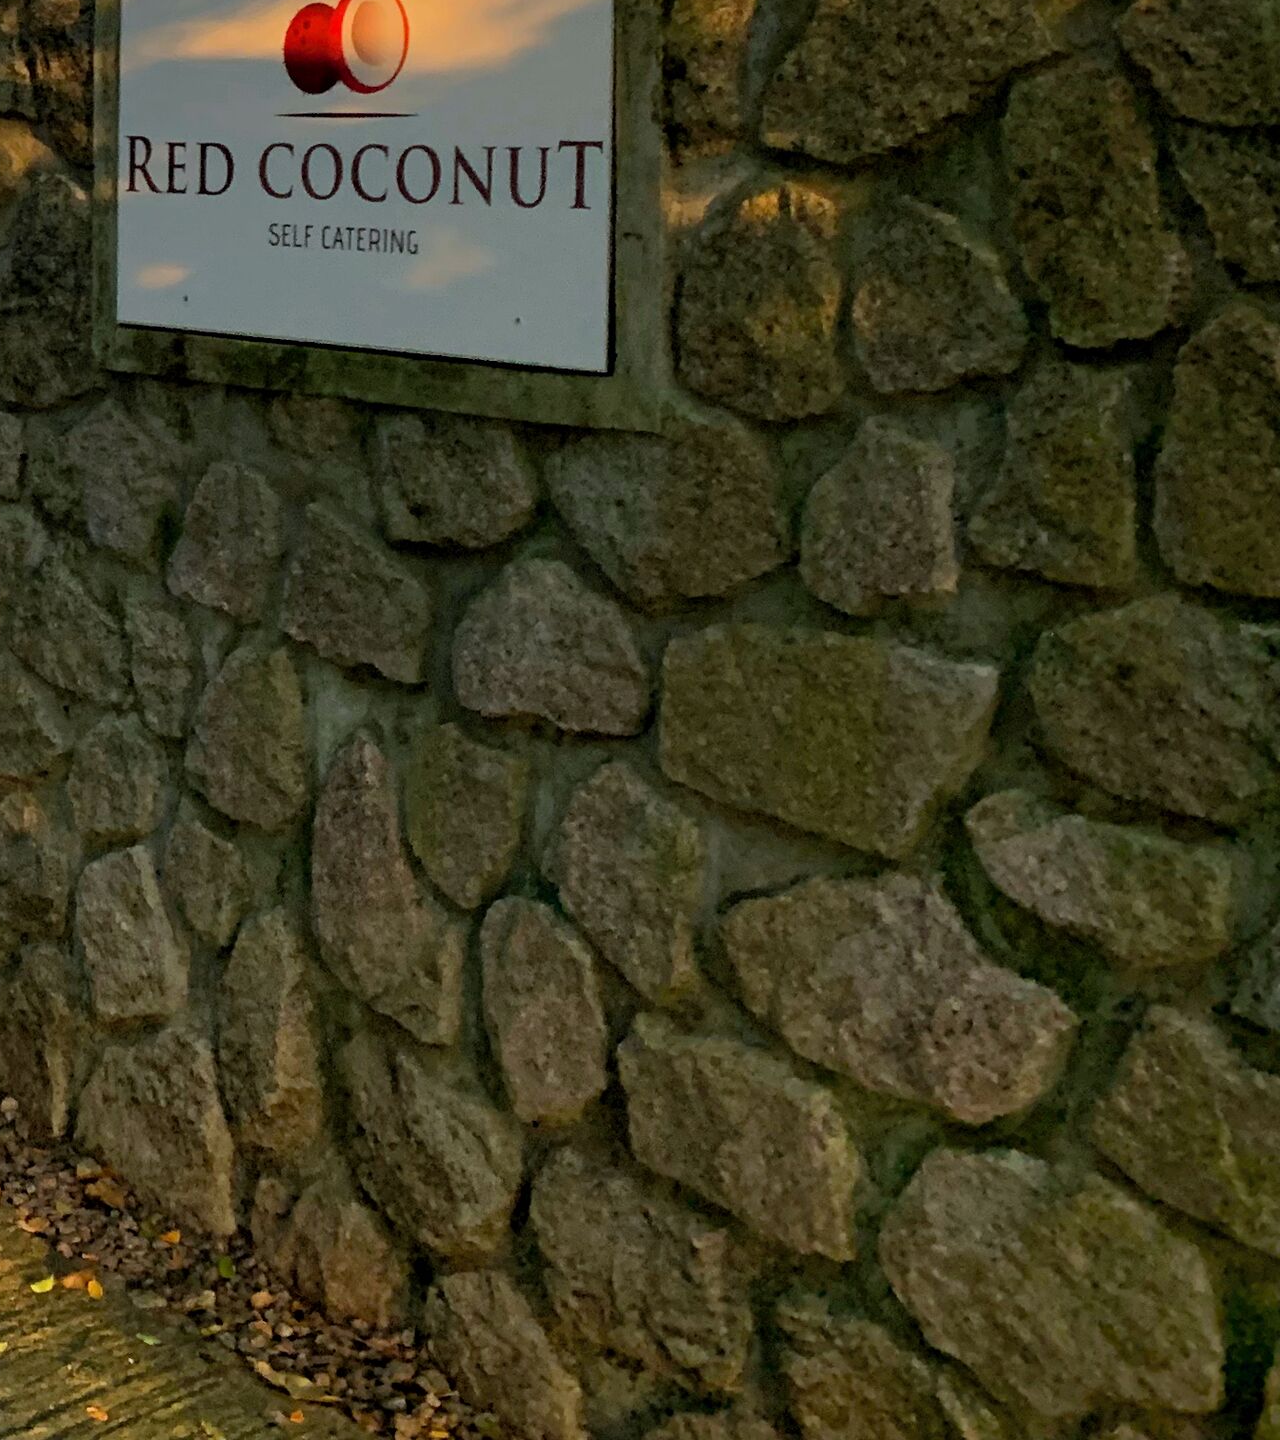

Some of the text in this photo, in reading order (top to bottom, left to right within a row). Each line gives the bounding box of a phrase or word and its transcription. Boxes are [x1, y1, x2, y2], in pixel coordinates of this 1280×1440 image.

[124, 135, 604, 210] RED COCONUT
[268, 223, 419, 255] SELF CATERING
